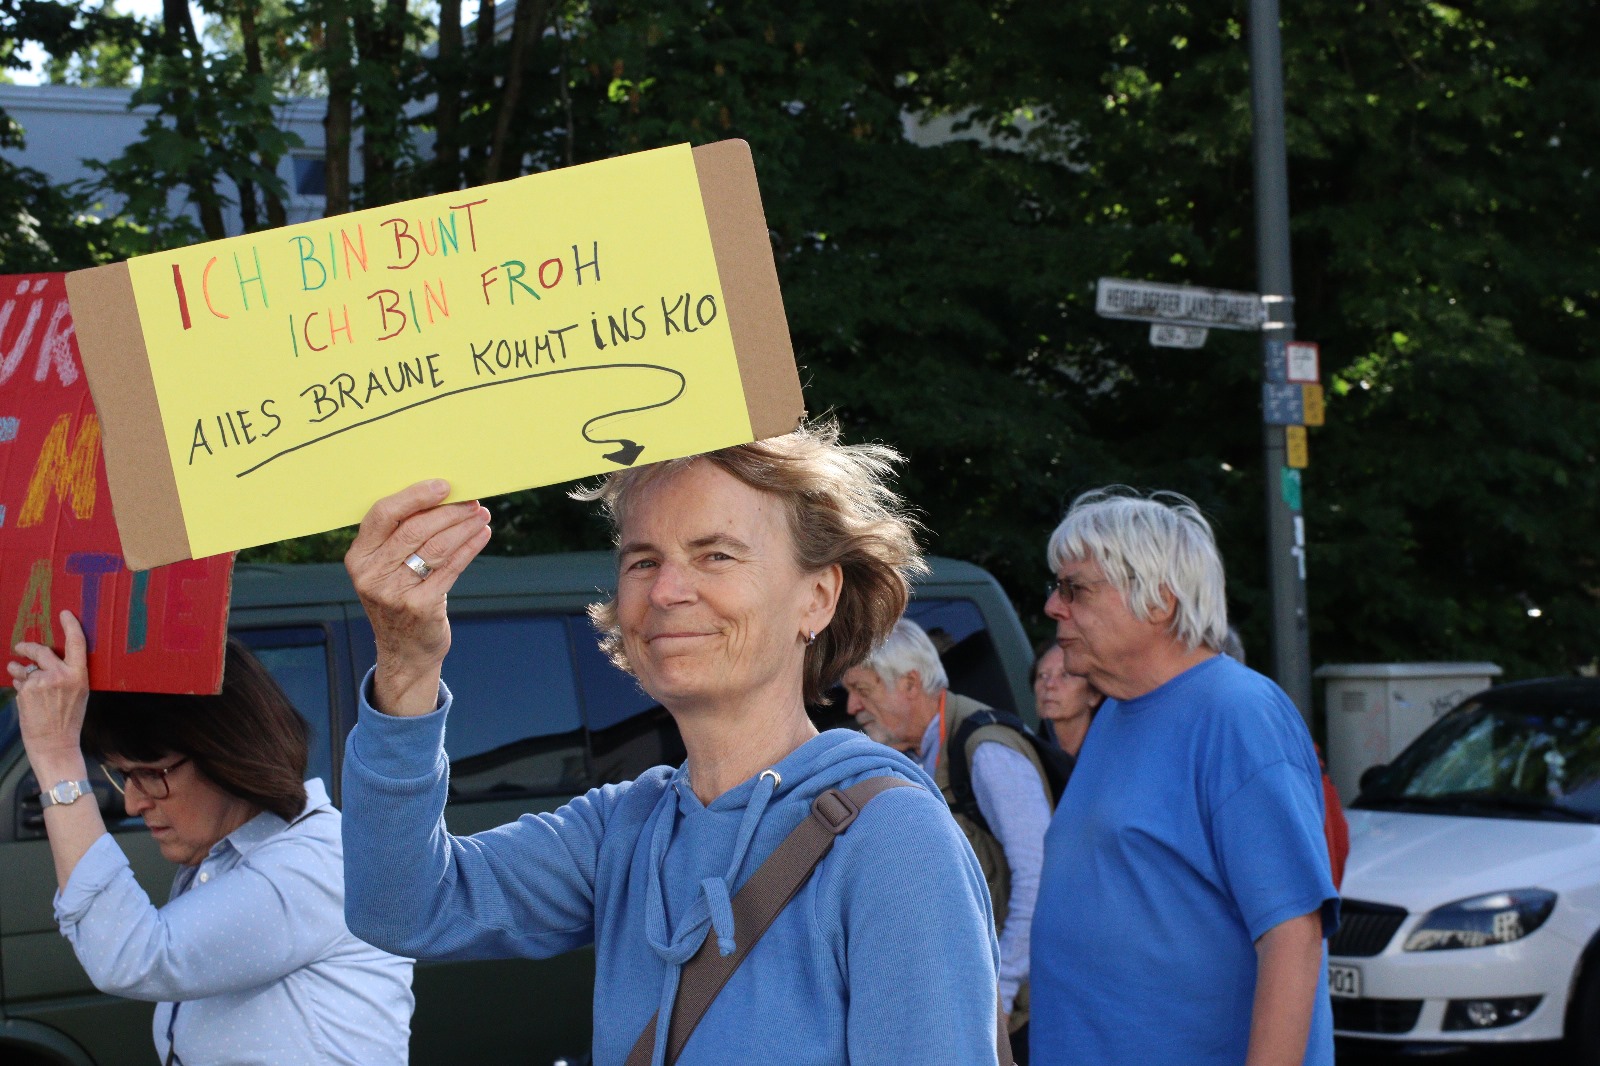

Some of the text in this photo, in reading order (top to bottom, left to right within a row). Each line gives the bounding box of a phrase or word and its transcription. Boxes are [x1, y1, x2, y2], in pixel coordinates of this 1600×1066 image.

[171, 199, 487, 330] ICH BIN BUNT
[290, 241, 601, 358] ICH BIN FROH
[299, 353, 445, 424] BRAUNE
[471, 323, 578, 372] KOMMT
